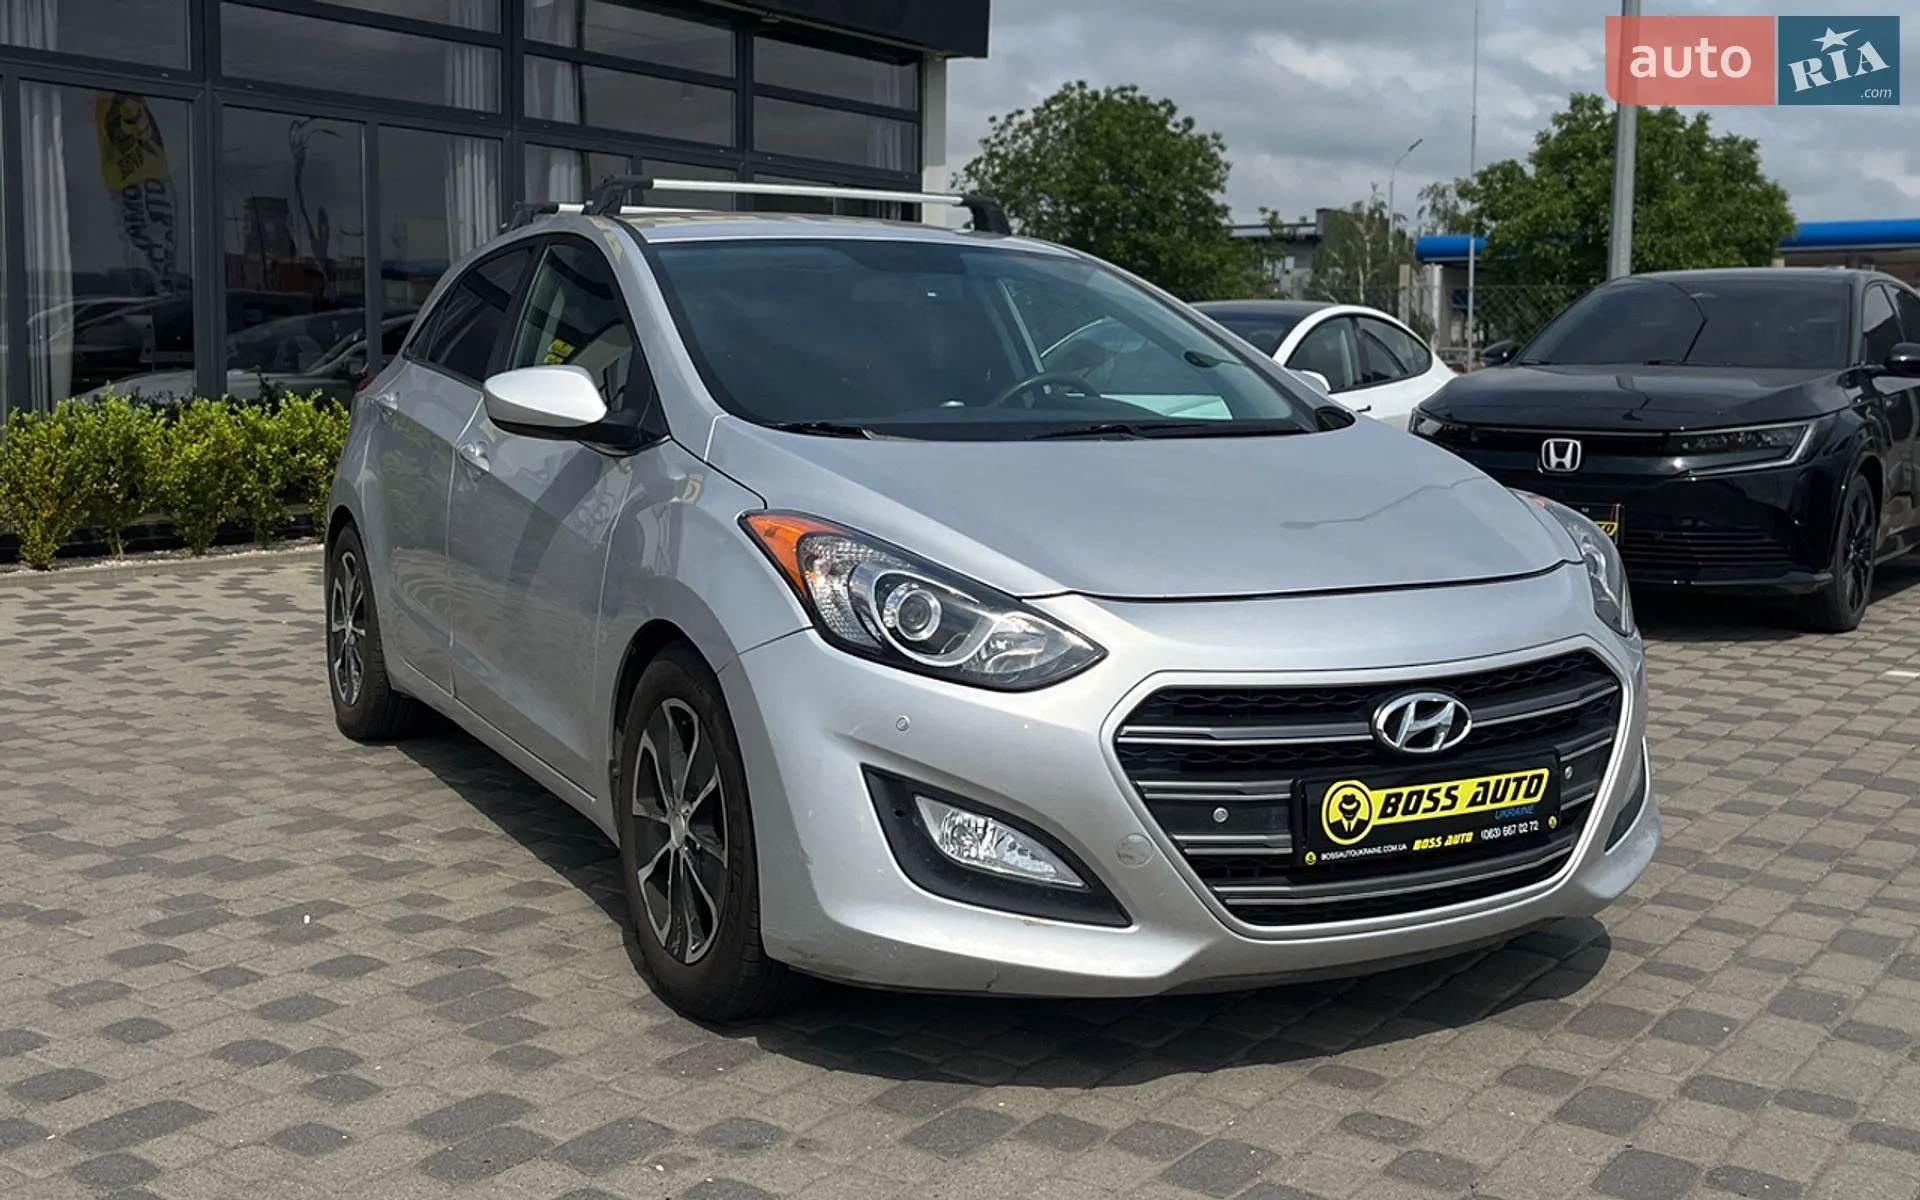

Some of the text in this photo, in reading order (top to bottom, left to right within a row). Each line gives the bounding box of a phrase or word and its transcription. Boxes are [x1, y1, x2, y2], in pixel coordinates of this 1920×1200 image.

[1377, 773, 1545, 819] BOSS AUTO
[1529, 820, 1539, 831] 72
[1412, 832, 1474, 850] BOSS AUTO
